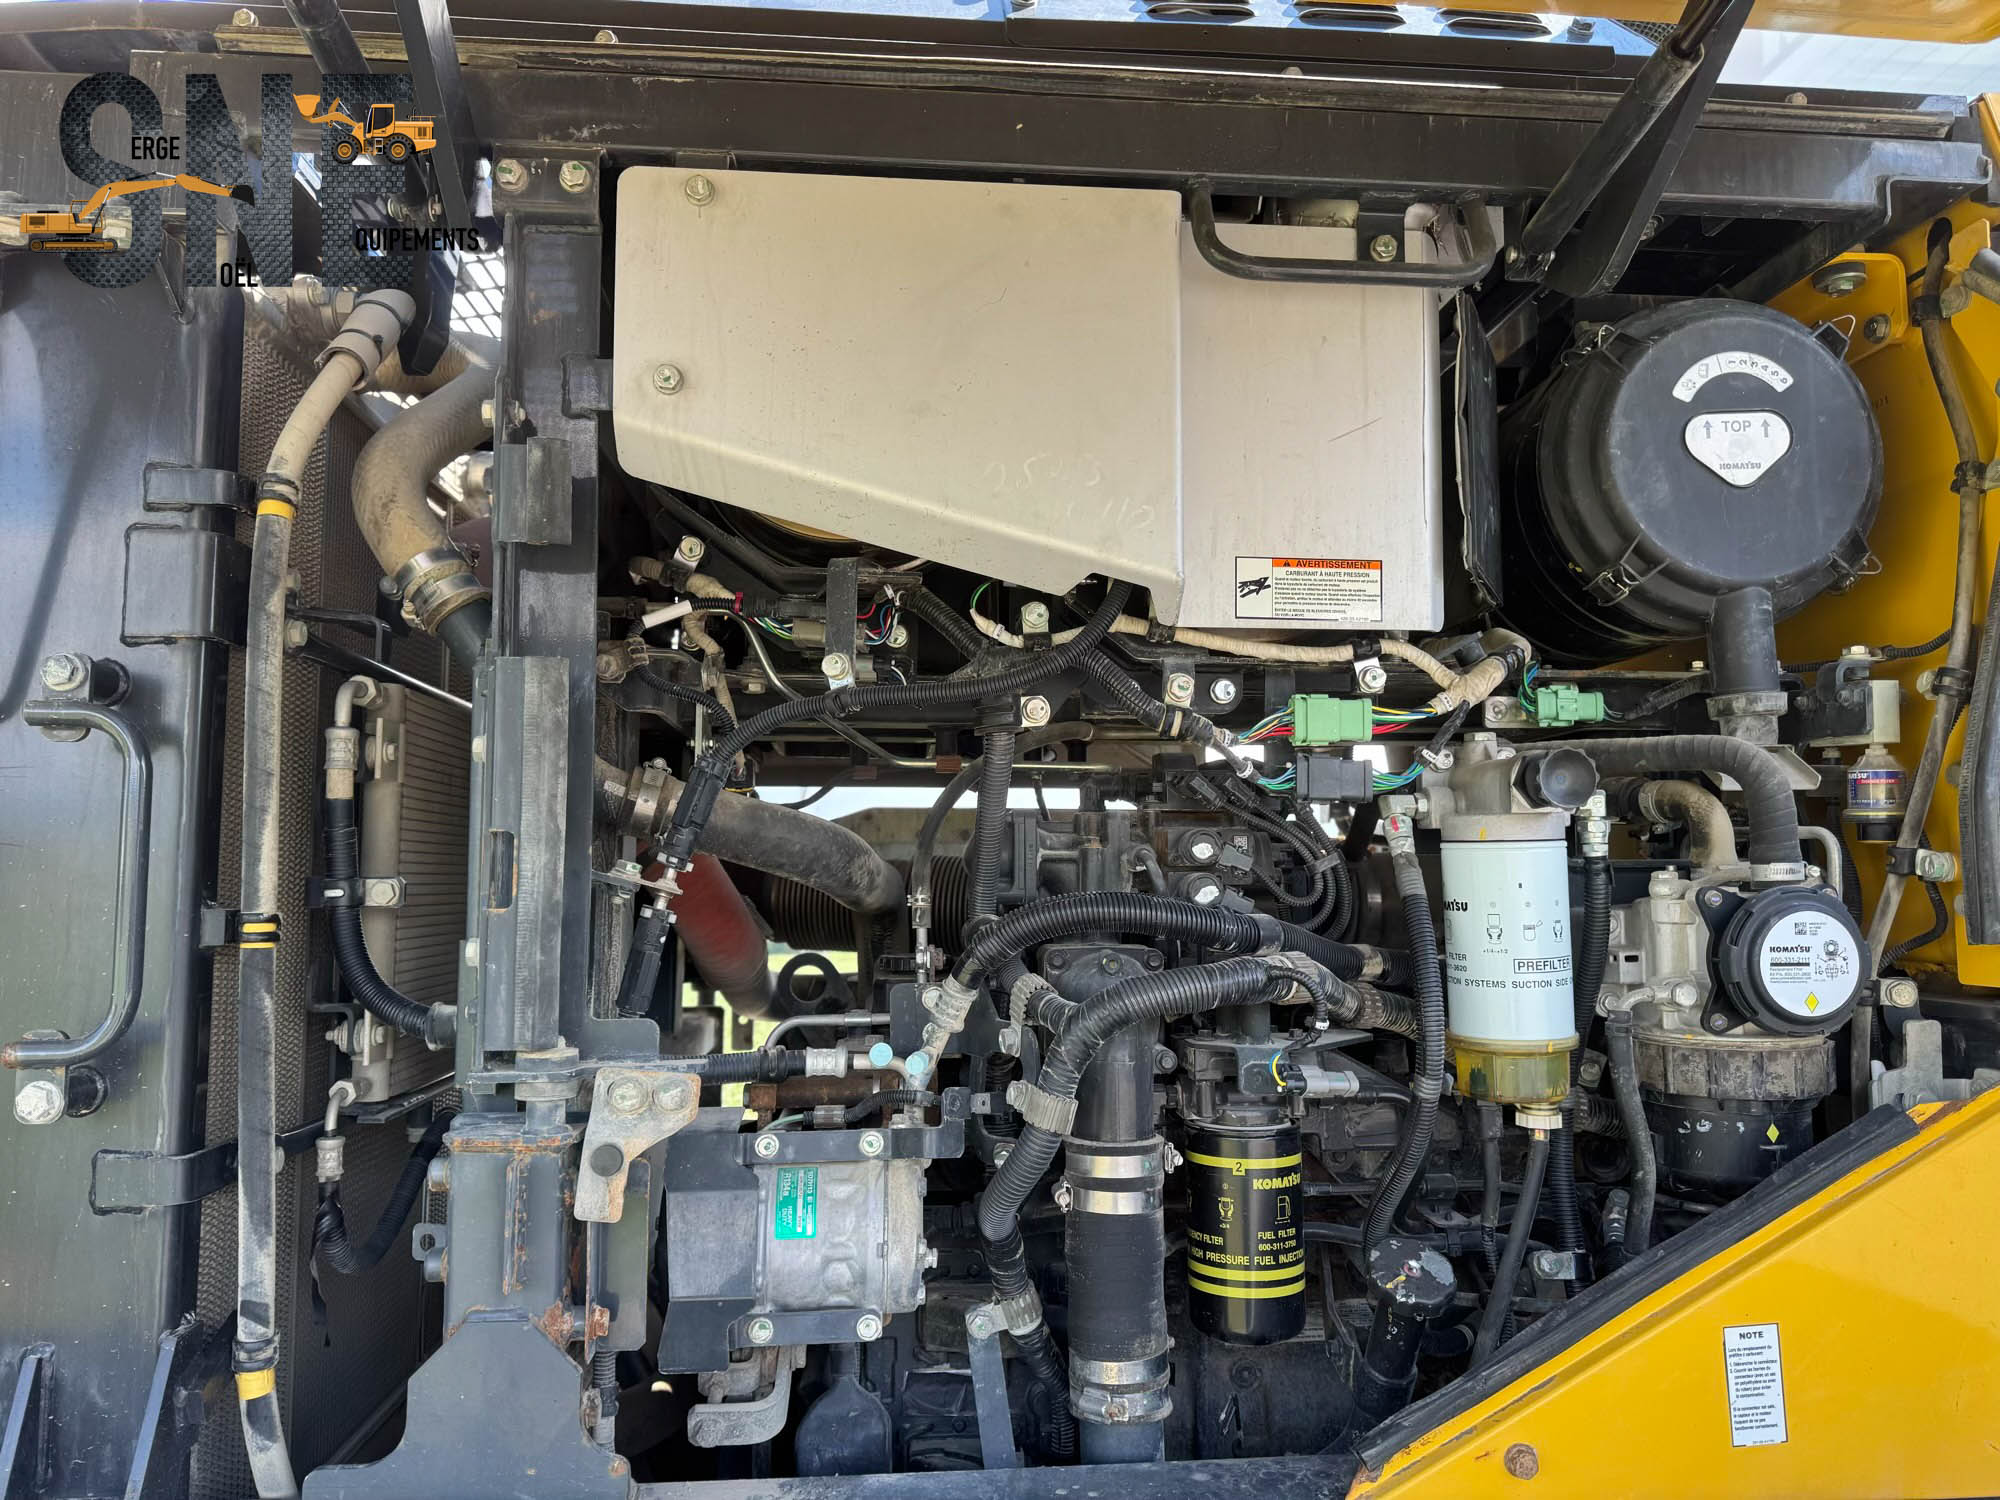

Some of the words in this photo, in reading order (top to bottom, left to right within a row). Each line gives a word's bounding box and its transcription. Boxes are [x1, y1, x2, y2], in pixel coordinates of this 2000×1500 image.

[1721, 420, 1752, 432] TOP
[1719, 461, 1762, 470] KOMATSU
[1296, 560, 1372, 569] AVERTISSEMENT
[1769, 945, 1811, 953] KOMATSU
[1517, 958, 1571, 971] PREFILTER
[1465, 979, 1506, 989] SYSTEMS
[1512, 980, 1553, 989] SUCTION
[1556, 977, 1569, 987] SIDE
[1235, 1161, 1243, 1173] 2
[1253, 1172, 1300, 1190] KOMATSU
[1203, 1234, 1224, 1246] FILTER
[1257, 1232, 1276, 1240] FUEL
[1278, 1228, 1297, 1238] FILTER
[1206, 1251, 1250, 1265] PRESSURE
[1254, 1256, 1276, 1265] FUEL
[1739, 1331, 1765, 1340] NOTE
